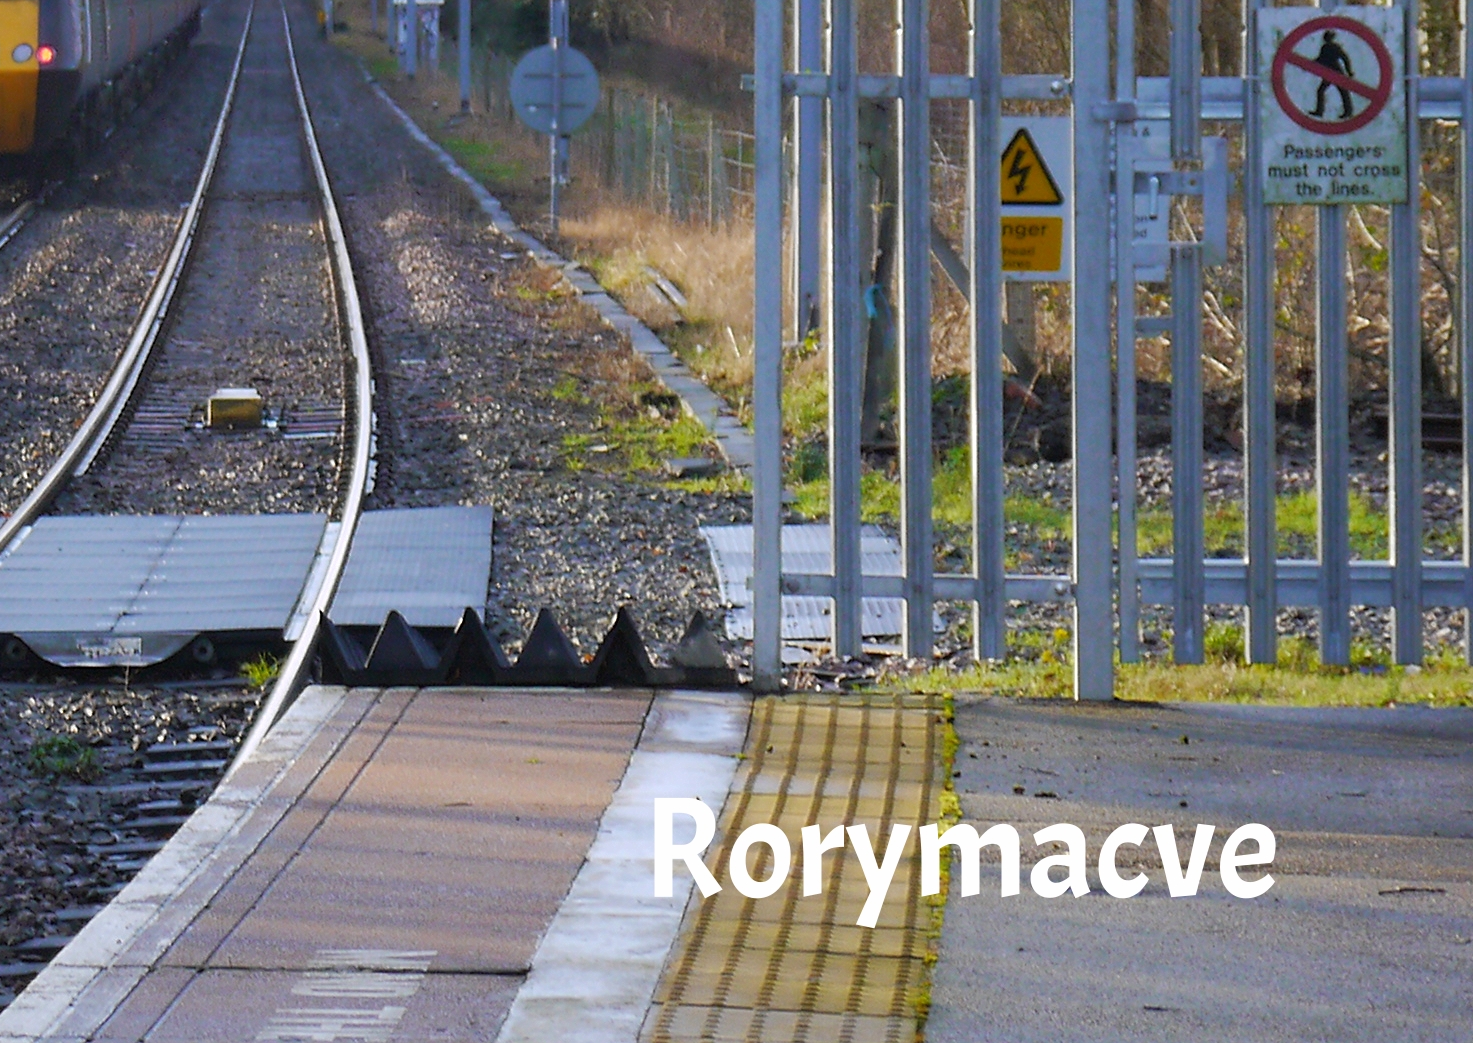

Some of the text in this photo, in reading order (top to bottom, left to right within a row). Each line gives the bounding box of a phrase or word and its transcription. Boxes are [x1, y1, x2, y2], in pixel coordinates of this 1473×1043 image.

[1283, 144, 1383, 161] Passengers
[1268, 163, 1401, 177] must not cross
[1295, 181, 1375, 196] the lines.
[1002, 225, 1047, 239] nger
